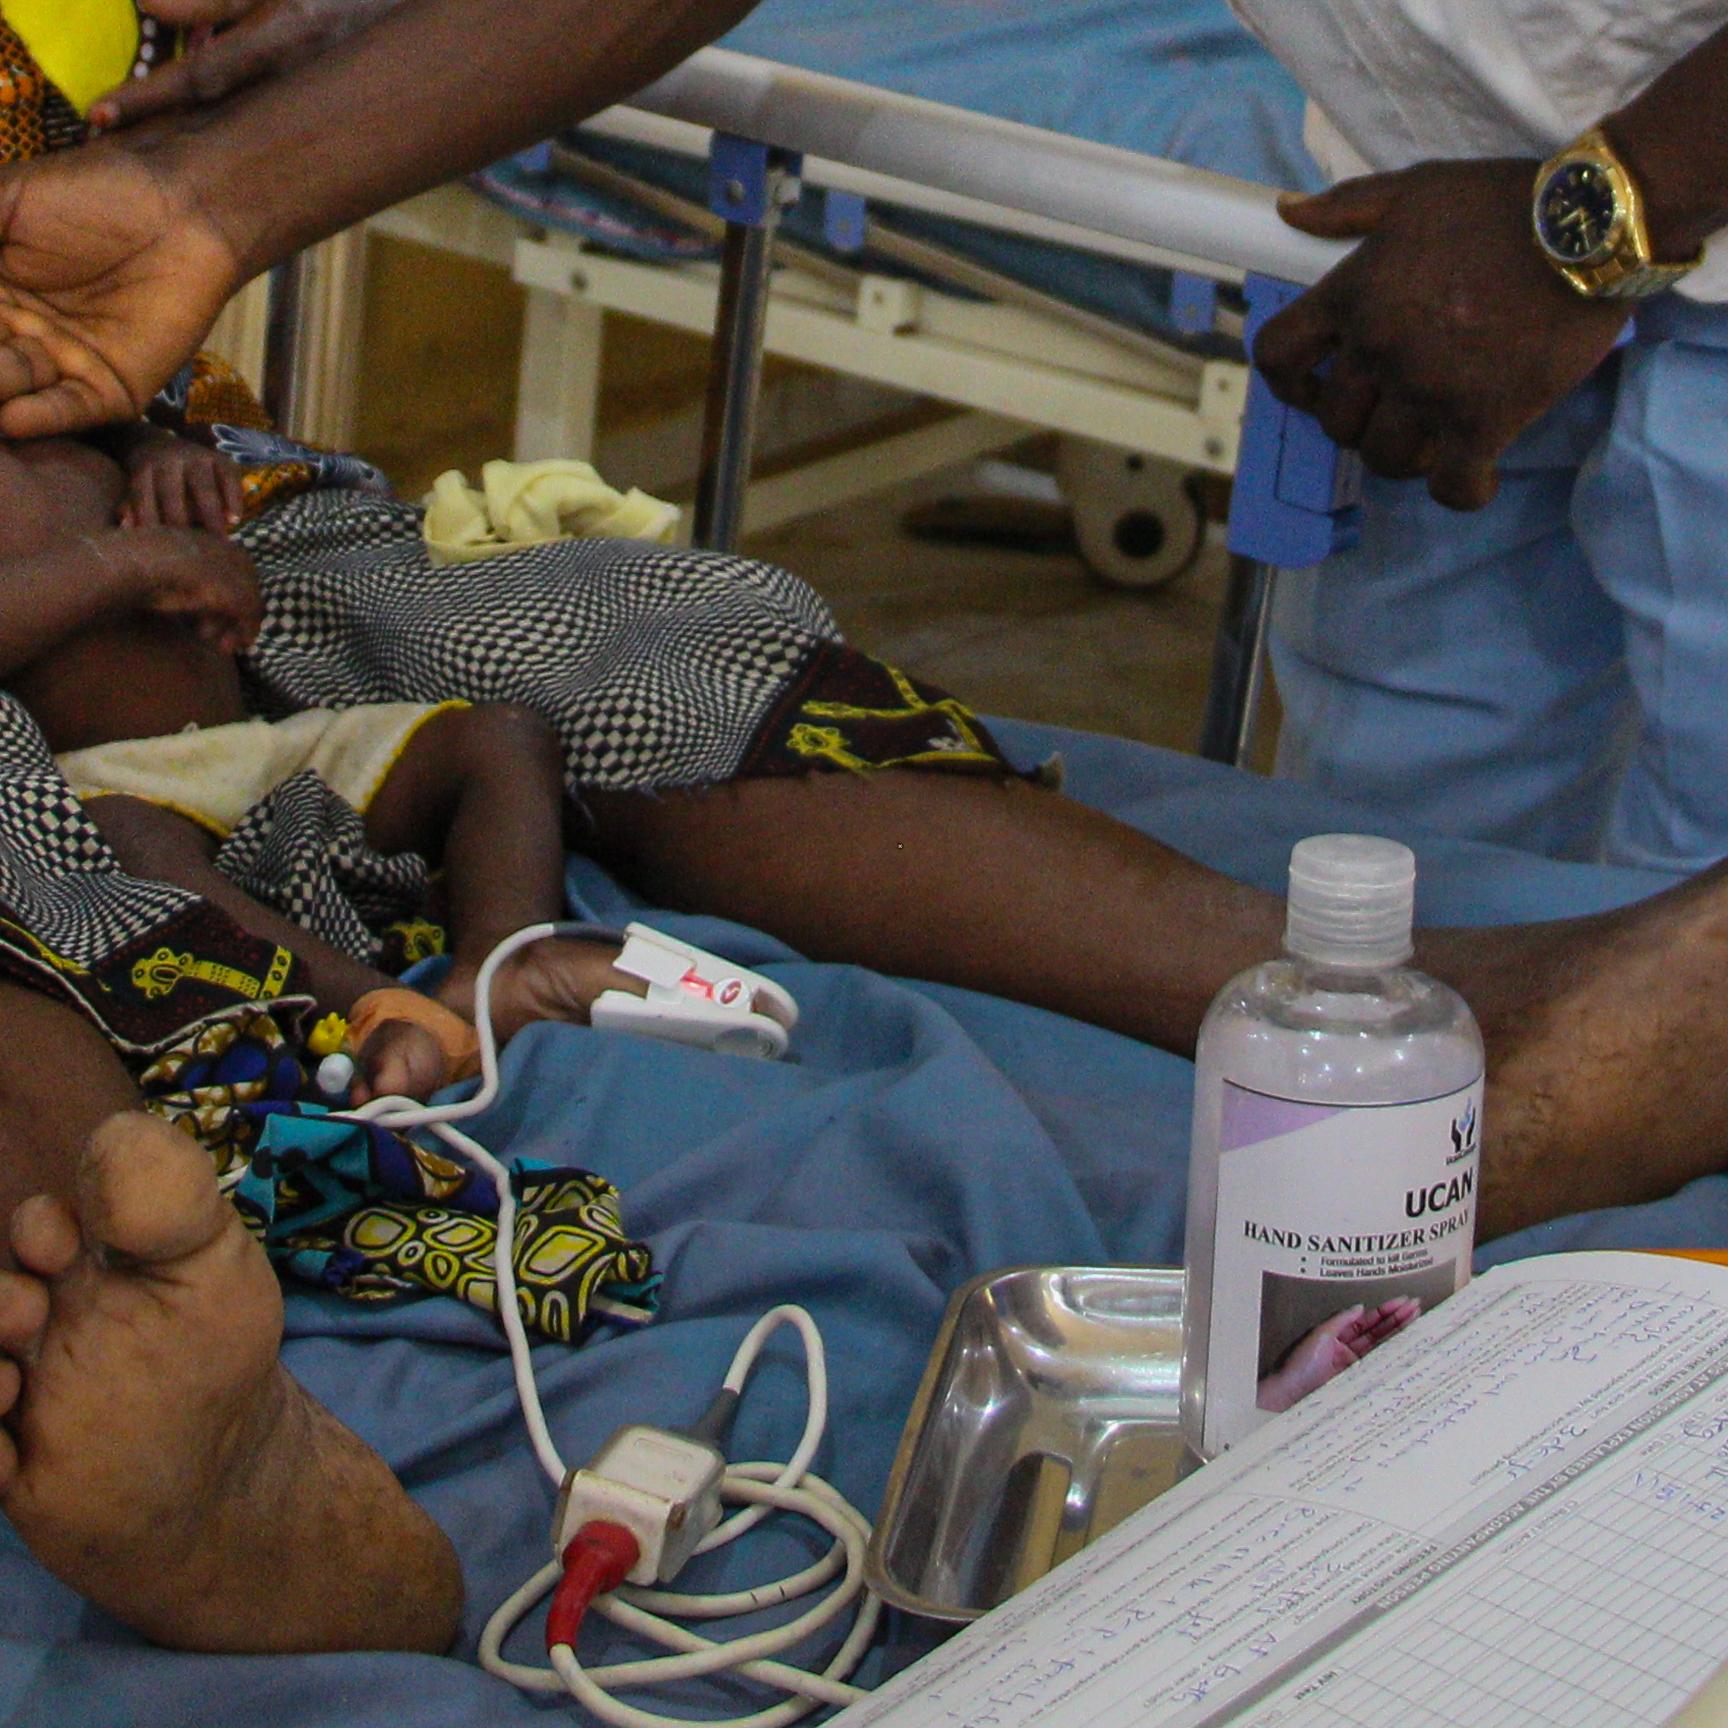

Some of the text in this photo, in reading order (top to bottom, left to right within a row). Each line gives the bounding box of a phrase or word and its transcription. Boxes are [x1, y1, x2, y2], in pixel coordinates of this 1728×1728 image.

[1405, 1167, 1473, 1218] UCAN
[1244, 1209, 1469, 1253] HAND SANITIZER SPRAY
